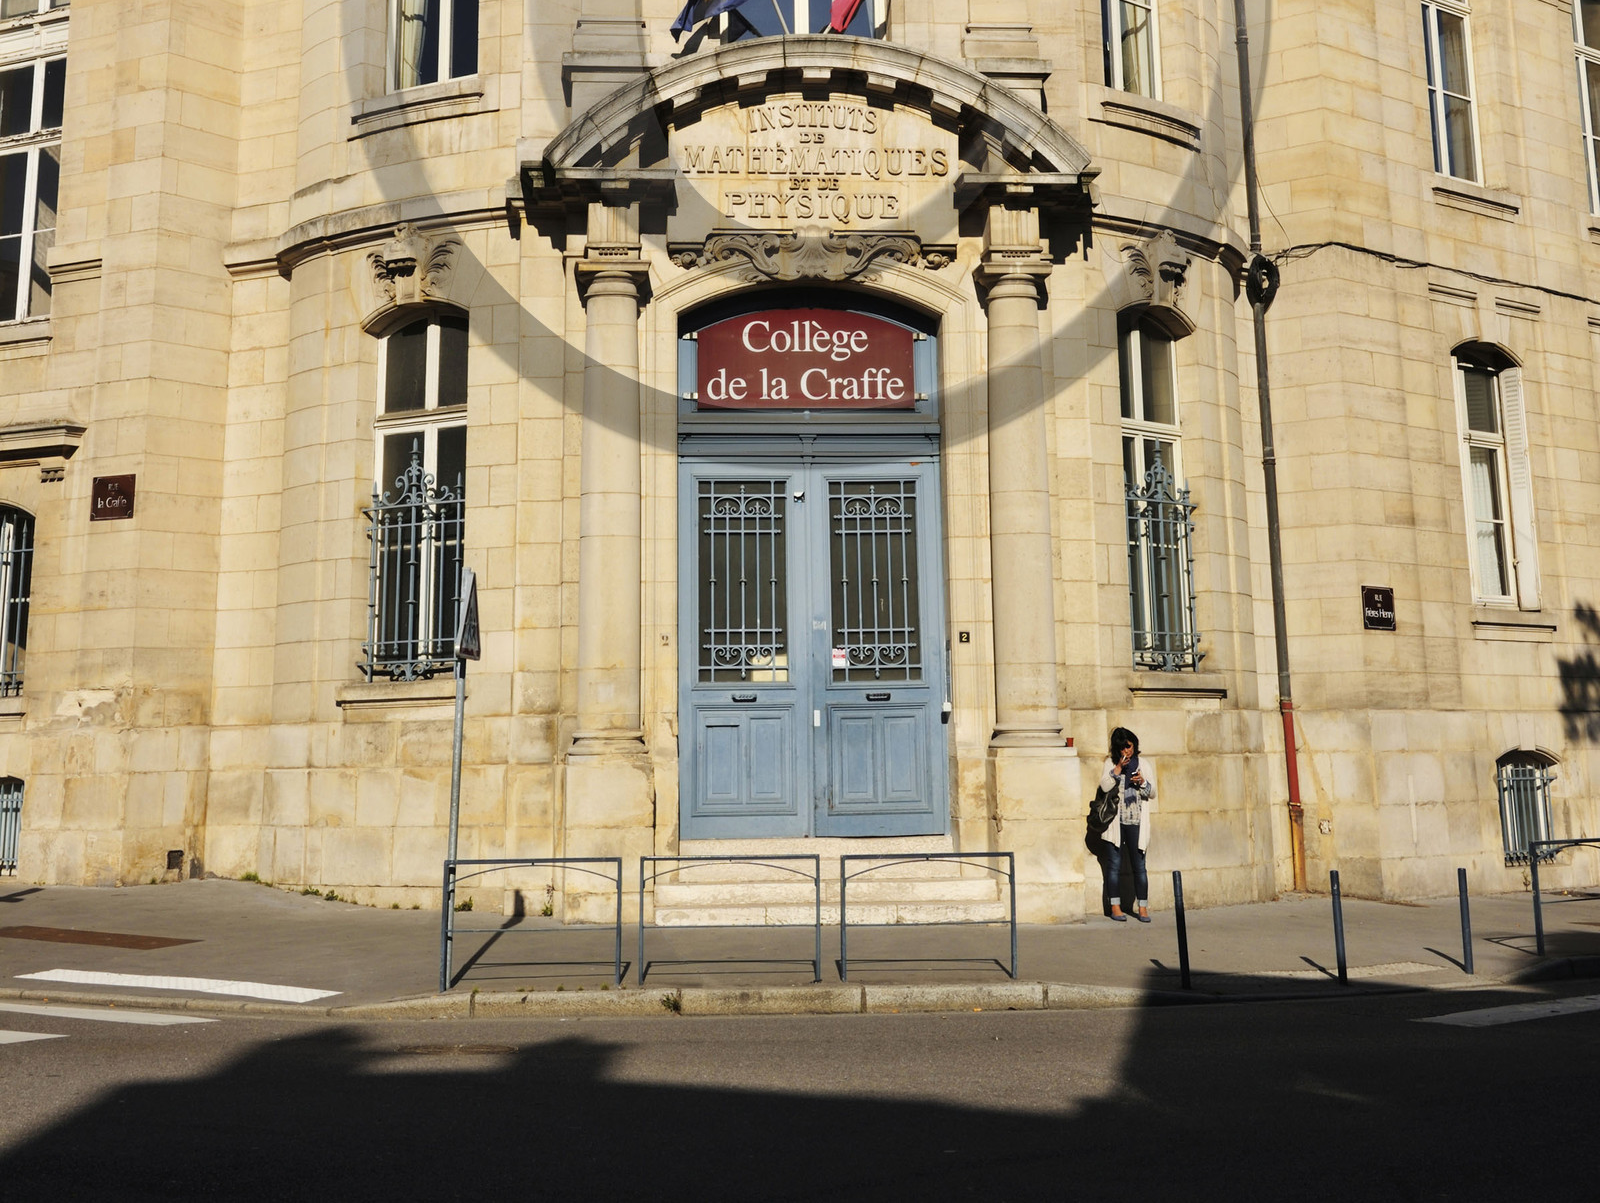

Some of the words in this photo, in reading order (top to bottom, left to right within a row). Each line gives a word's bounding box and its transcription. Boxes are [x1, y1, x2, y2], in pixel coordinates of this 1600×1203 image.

[749, 103, 878, 134] INSTITUTS
[799, 133, 825, 144] DE
[682, 142, 949, 181] MATHÉMATIQUES
[789, 178, 812, 191] ET
[817, 178, 840, 191] DE
[725, 191, 900, 224] PHYSIQUE
[742, 320, 869, 362] Collège
[706, 368, 748, 401] de
[759, 368, 790, 400] la
[800, 367, 905, 400] Craffe
[961, 632, 968, 642] 2
